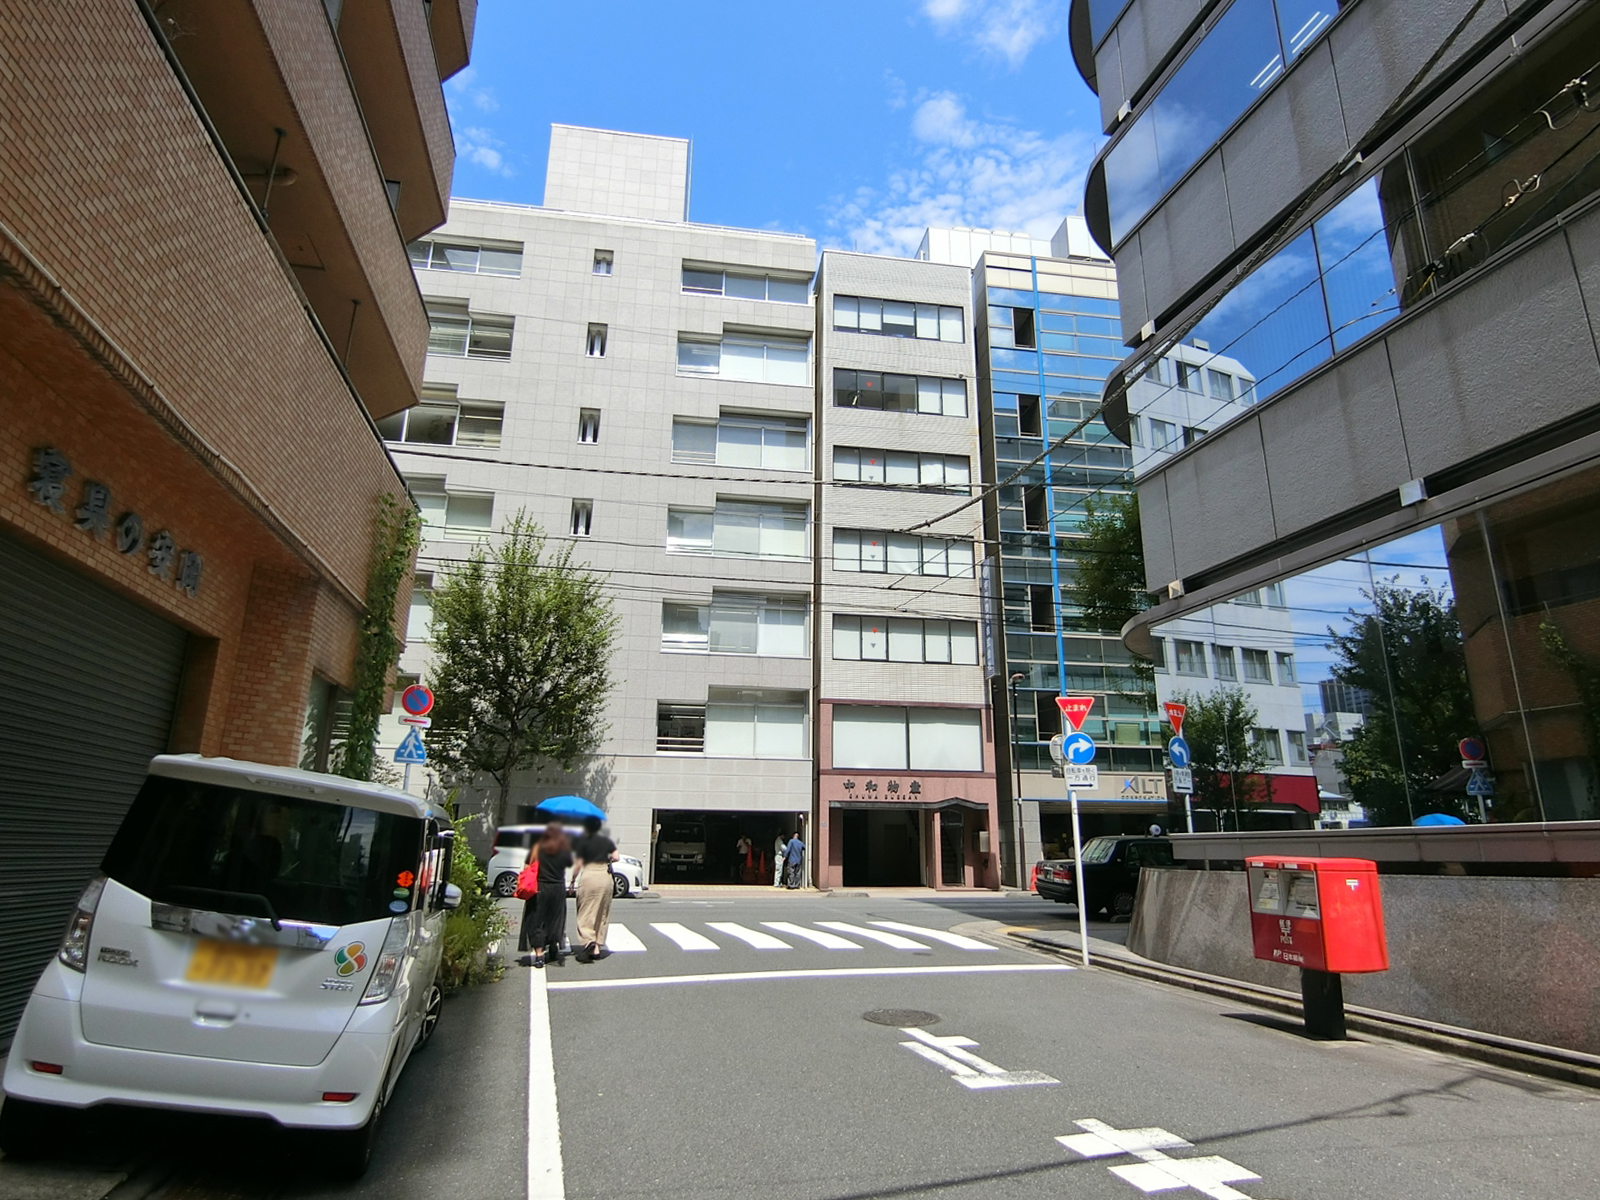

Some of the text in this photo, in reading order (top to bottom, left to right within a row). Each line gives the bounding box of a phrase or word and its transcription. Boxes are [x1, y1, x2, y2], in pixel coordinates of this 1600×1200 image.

[1065, 704, 1087, 712] 止まれ
[1067, 774, 1096, 782] 一方通行
[843, 779, 922, 795] 中和物産
